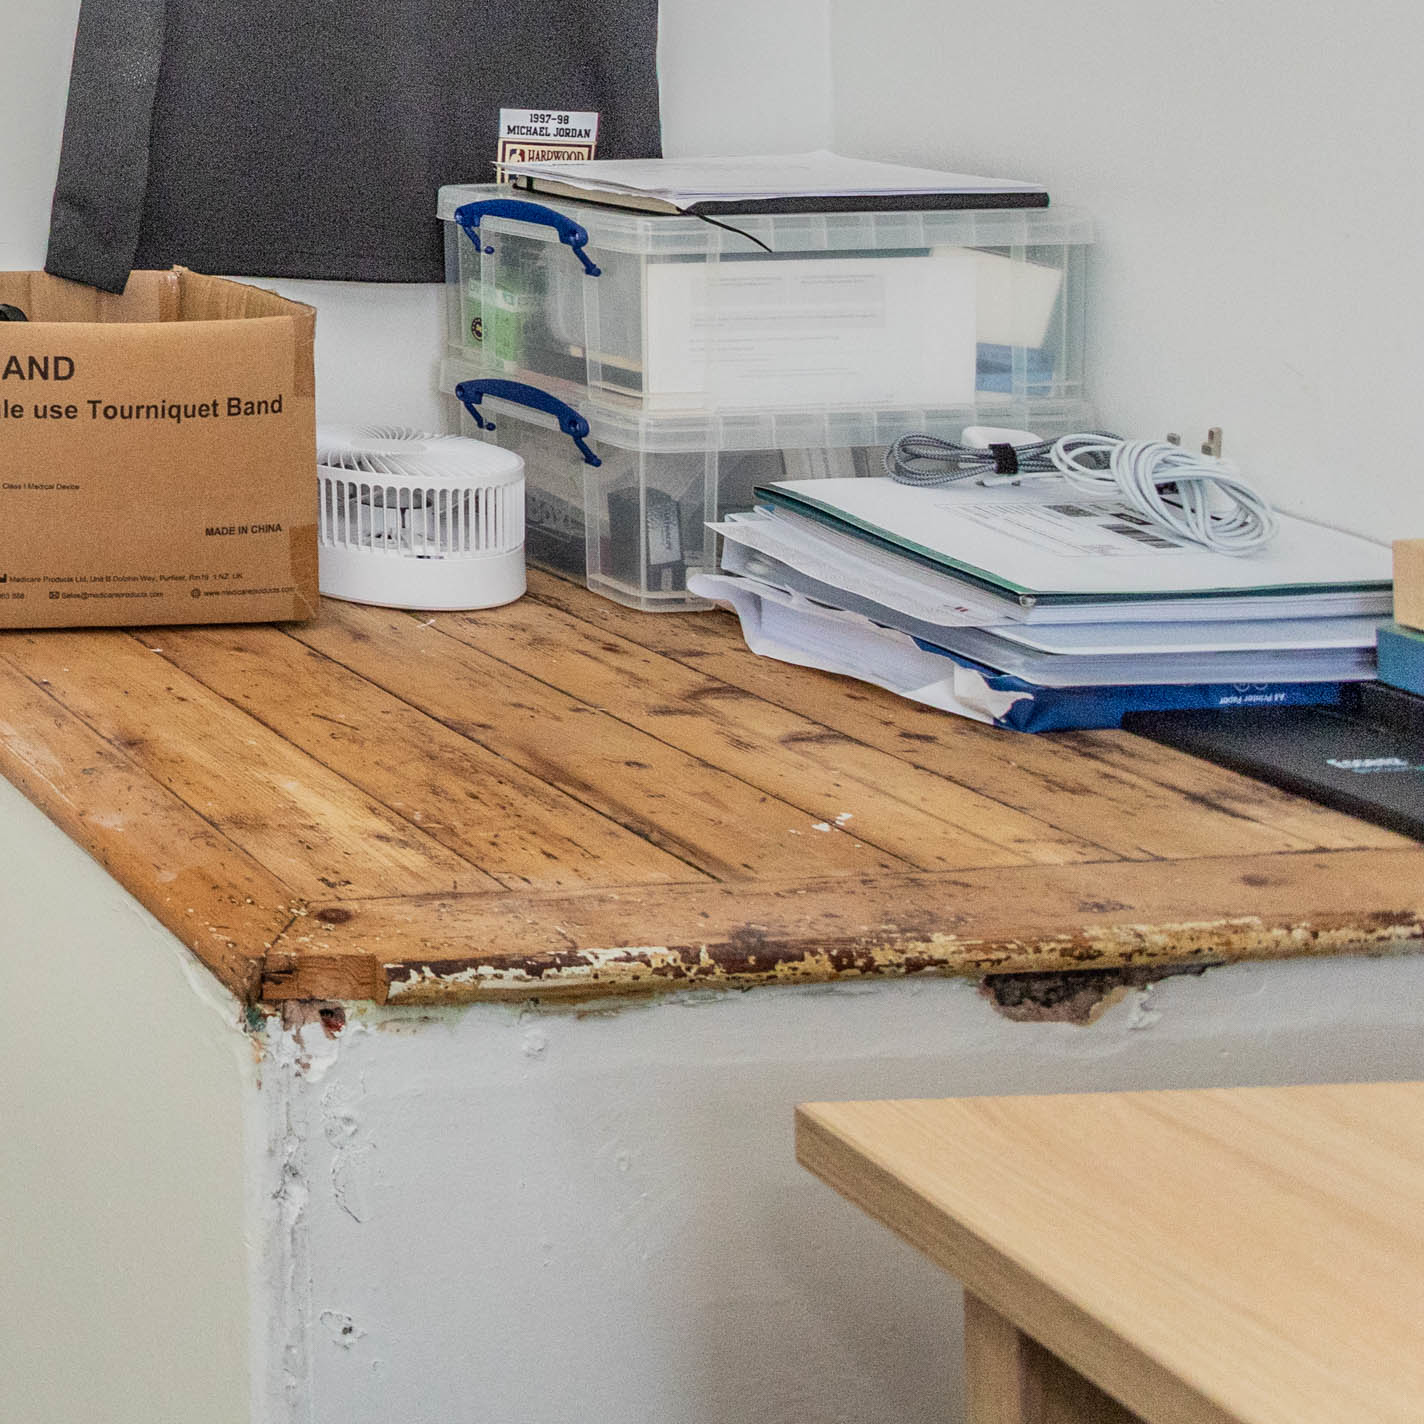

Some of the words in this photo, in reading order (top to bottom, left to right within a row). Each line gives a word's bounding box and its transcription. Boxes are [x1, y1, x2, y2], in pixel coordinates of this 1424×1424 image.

[529, 113, 569, 125] 1997-98
[507, 125, 551, 137] MICHAEL
[553, 127, 592, 138] JORDAN
[528, 149, 584, 161] HARDWOOD
[34, 403, 78, 419] use
[87, 399, 219, 423] Tourniquet
[226, 394, 283, 417] Band
[205, 527, 235, 536] MADE
[238, 525, 248, 535] IN
[251, 523, 282, 534] CHINA
[1219, 696, 1242, 705] Paper
[1243, 693, 1272, 702] Printer
